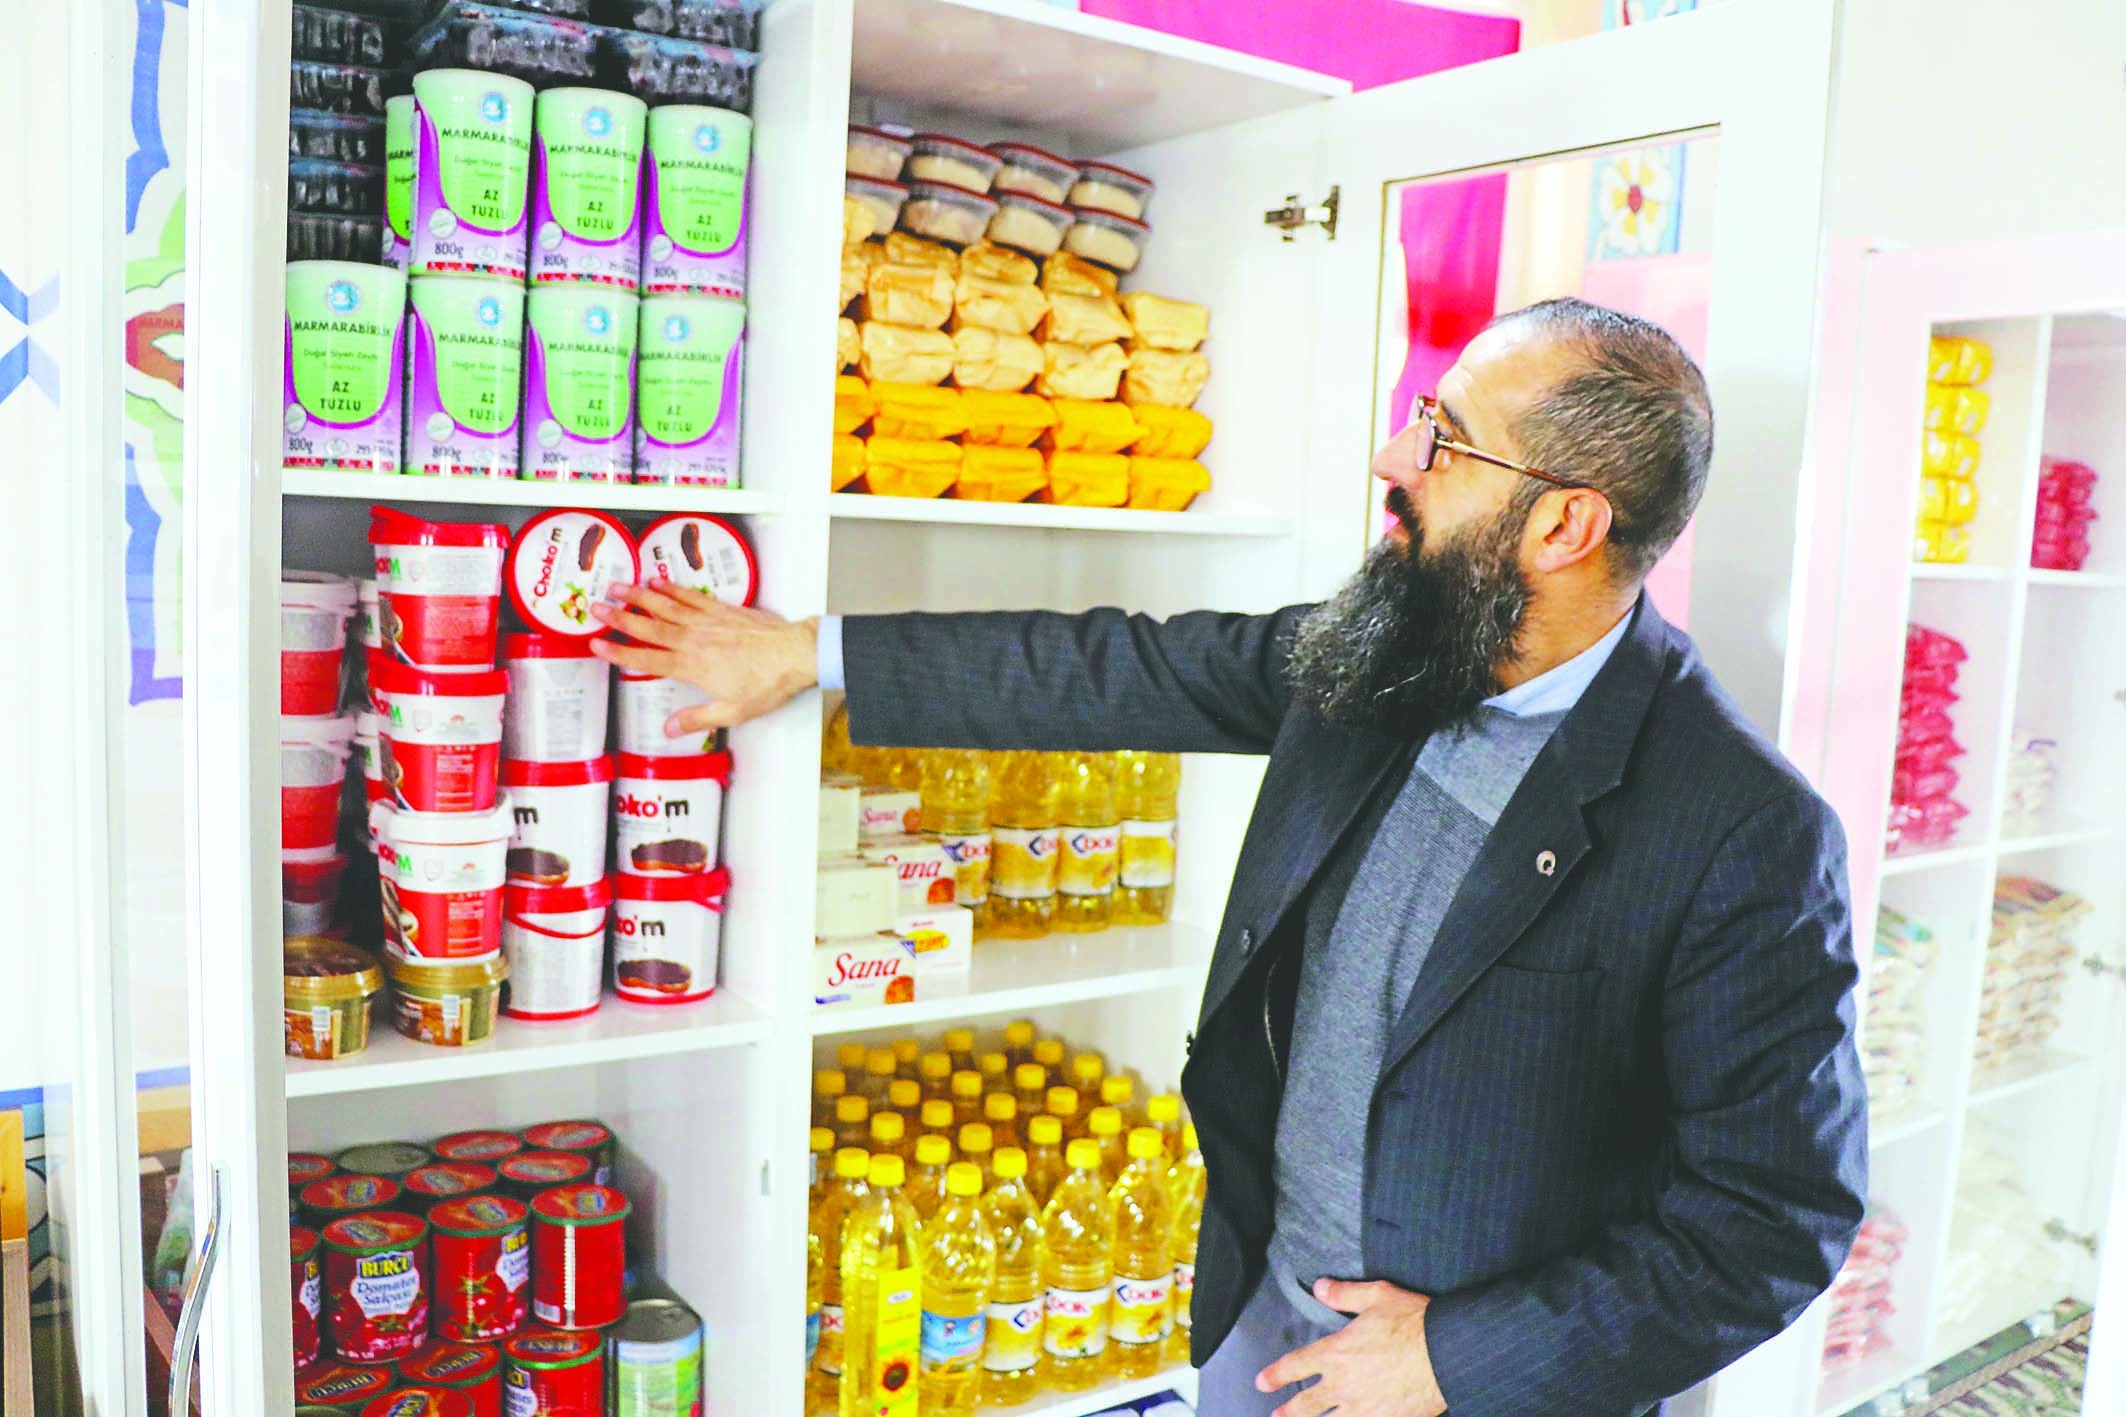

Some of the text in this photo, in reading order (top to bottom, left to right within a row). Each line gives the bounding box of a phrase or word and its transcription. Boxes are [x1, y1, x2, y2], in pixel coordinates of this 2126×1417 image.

[483, 189, 499, 201] AZ
[587, 201, 603, 212] AZ
[577, 217, 614, 230] TUZLU
[696, 215, 712, 226] AZ
[686, 230, 722, 242] TUZLU
[435, 242, 463, 259] 800g
[332, 381, 350, 393] AZ
[481, 392, 495, 404] AZ
[320, 398, 362, 411] TUZLU
[588, 399, 602, 411] AZ
[667, 405, 682, 416] AZ
[657, 421, 692, 432] TUZLU
[289, 437, 313, 454] 800g
[827, 952, 901, 987] Sana
